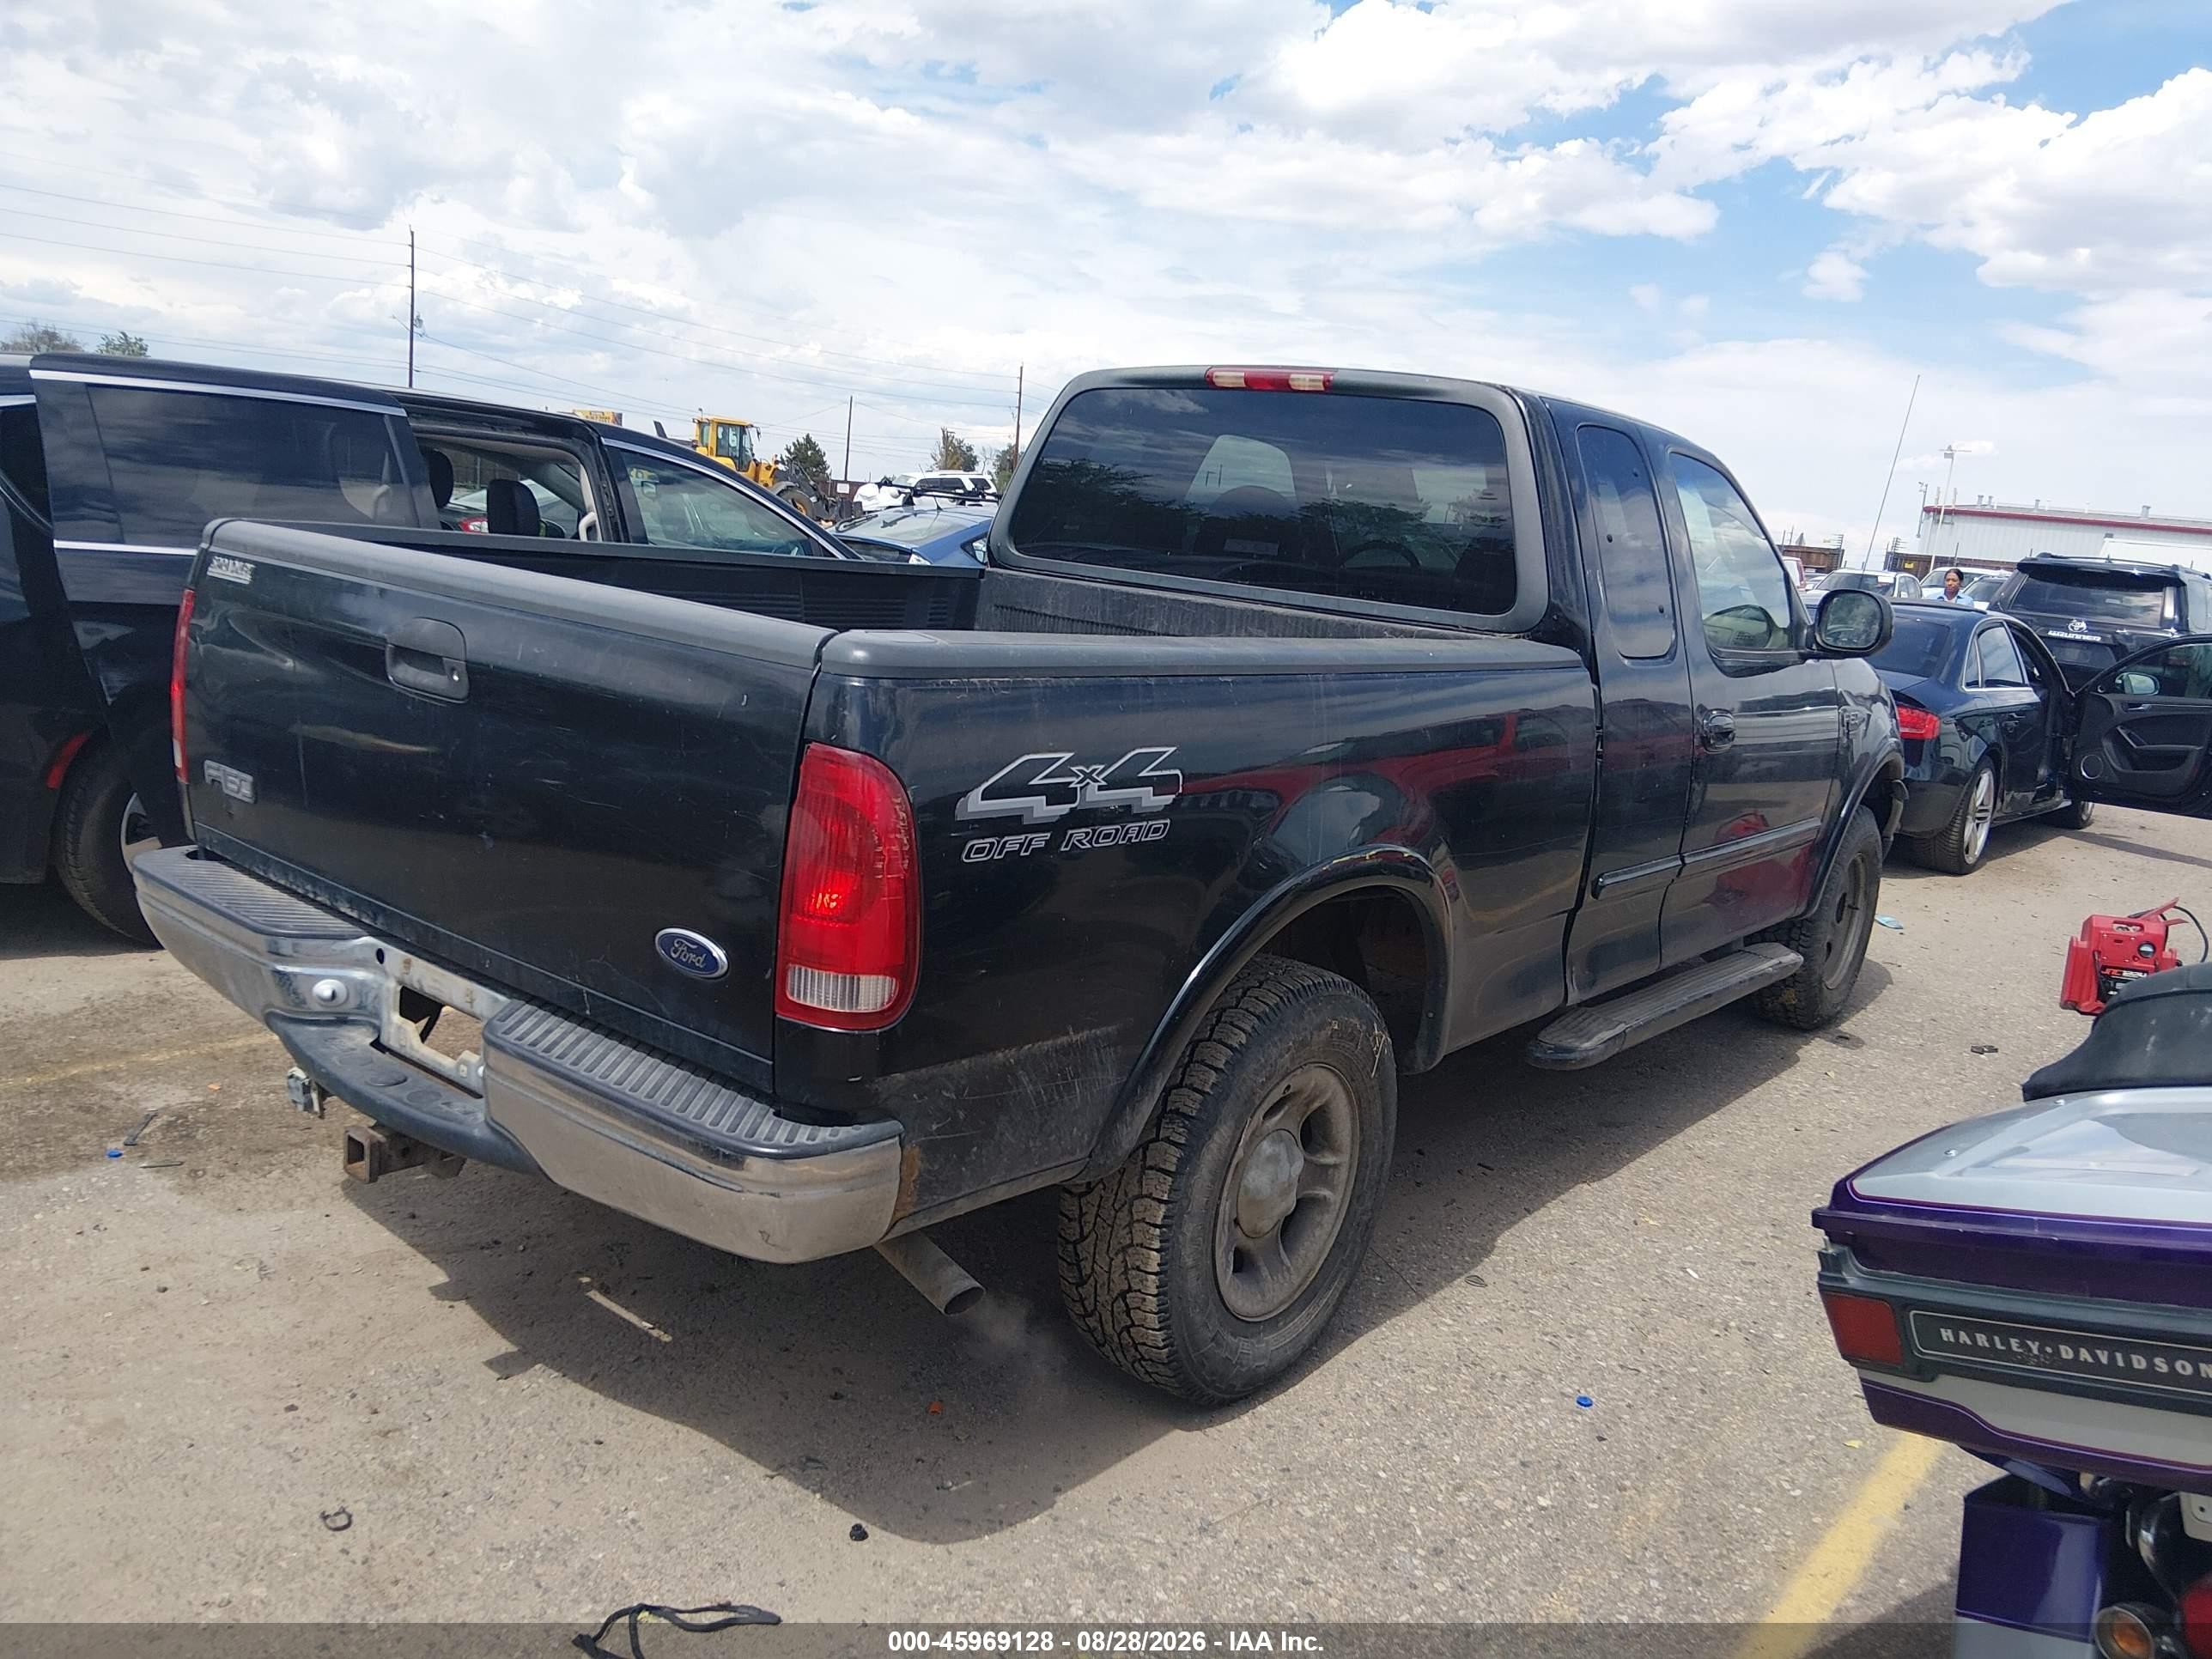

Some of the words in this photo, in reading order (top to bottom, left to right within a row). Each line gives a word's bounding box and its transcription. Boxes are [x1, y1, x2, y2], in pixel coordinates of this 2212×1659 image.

[961, 831, 1051, 864] OFF
[1060, 818, 1171, 852] ROAD
[670, 938, 707, 969] Ford
